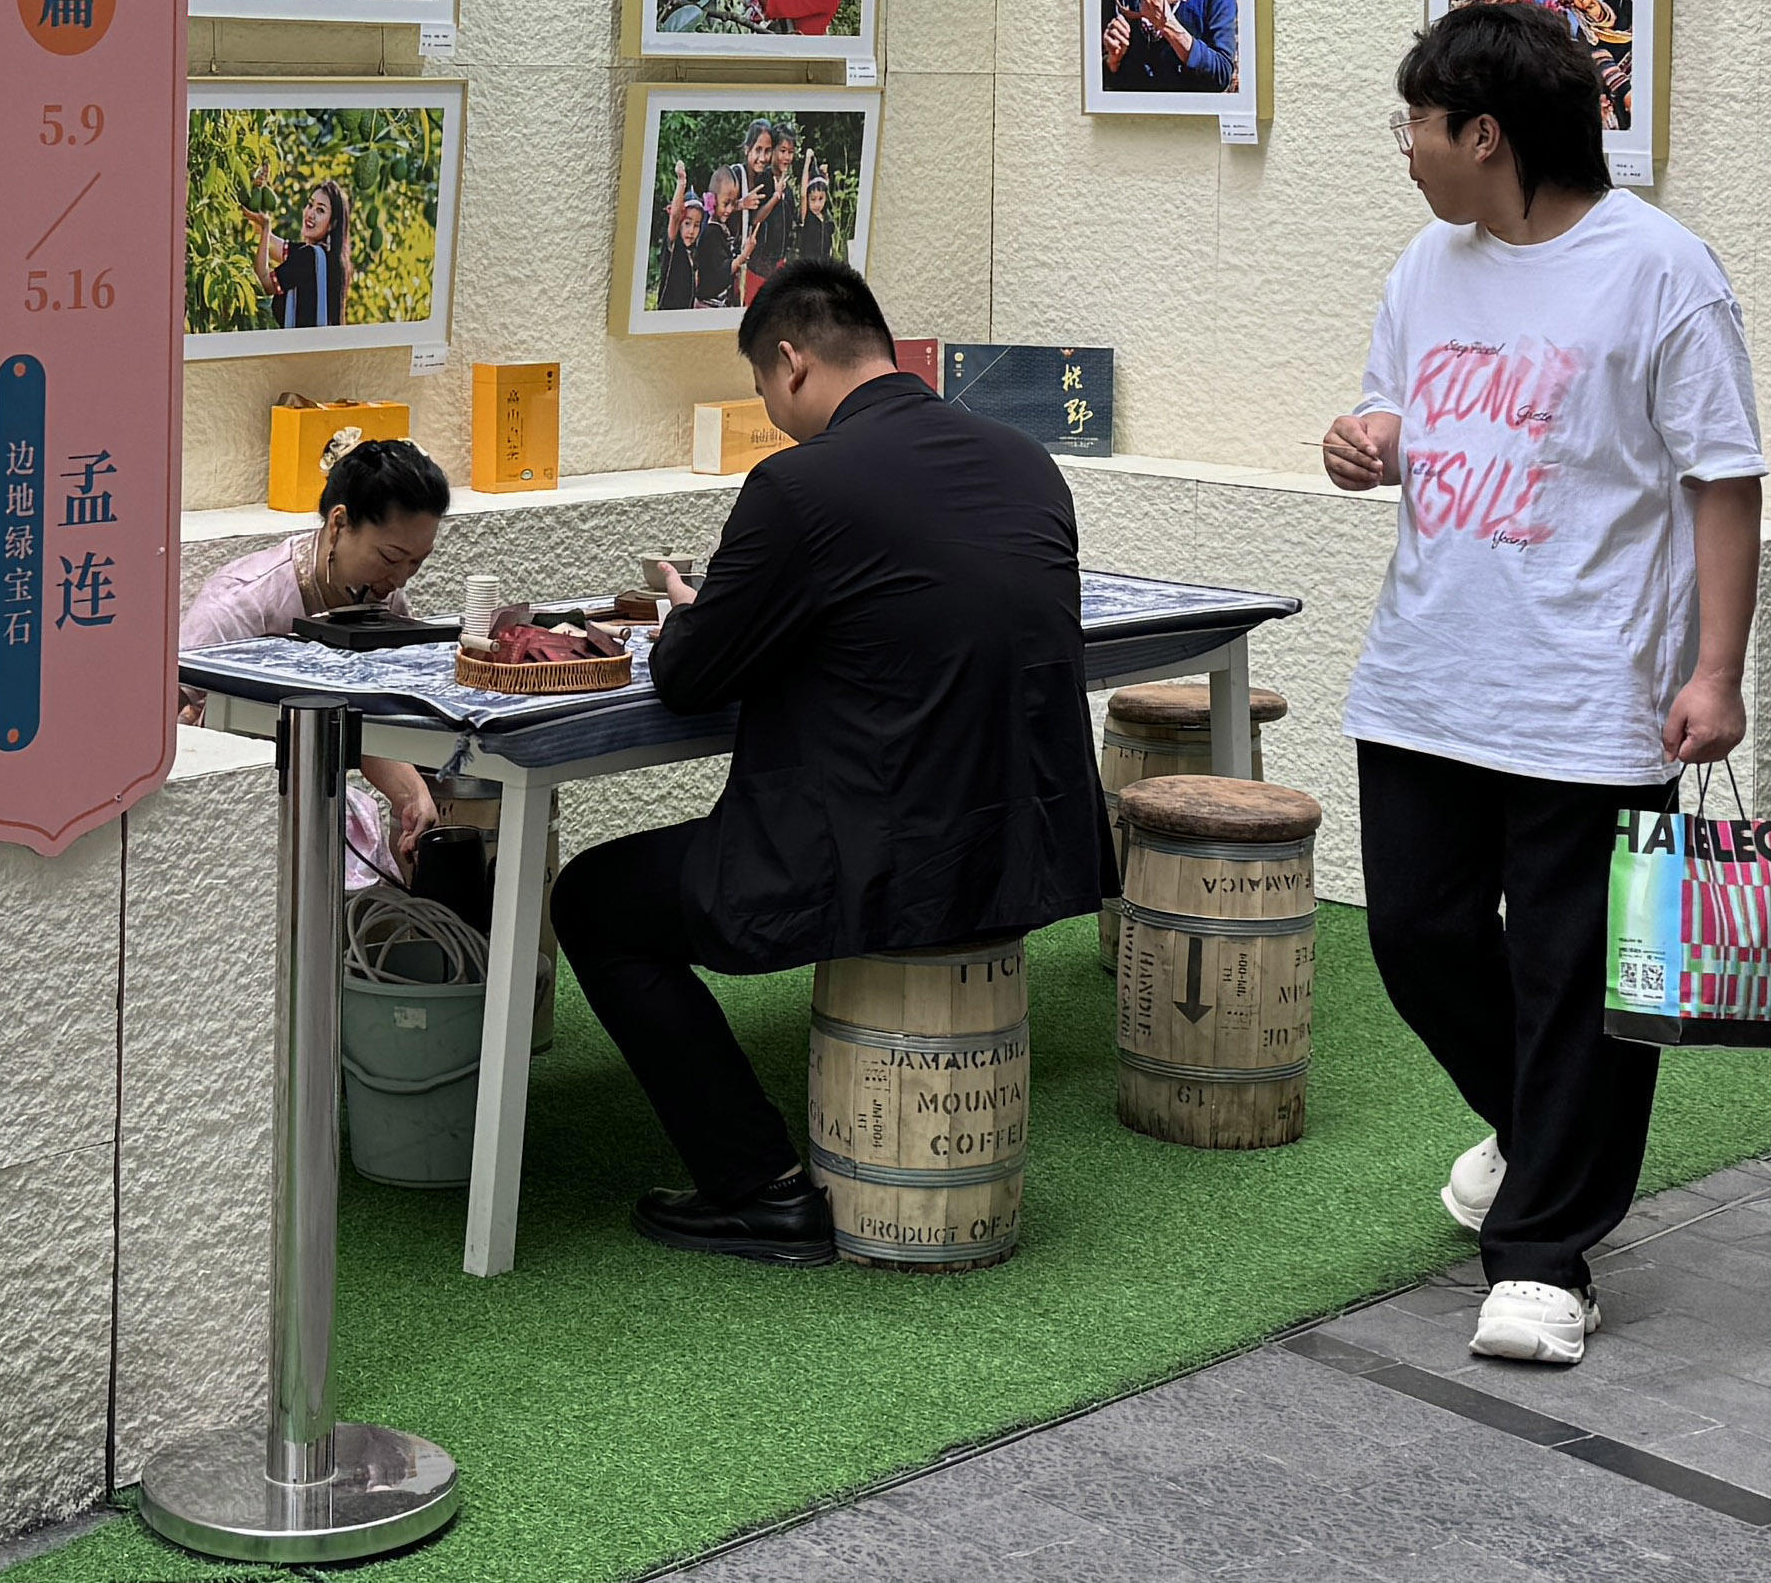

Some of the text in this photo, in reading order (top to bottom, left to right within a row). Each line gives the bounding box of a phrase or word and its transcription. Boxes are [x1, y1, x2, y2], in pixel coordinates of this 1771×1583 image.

[39, 103, 105, 147] 5.9
[25, 266, 117, 313] 5.16
[4, 440, 35, 646] 边地绿宝石
[55, 450, 119, 631] 孟连
[860, 1215, 958, 1245] PRODUCT
